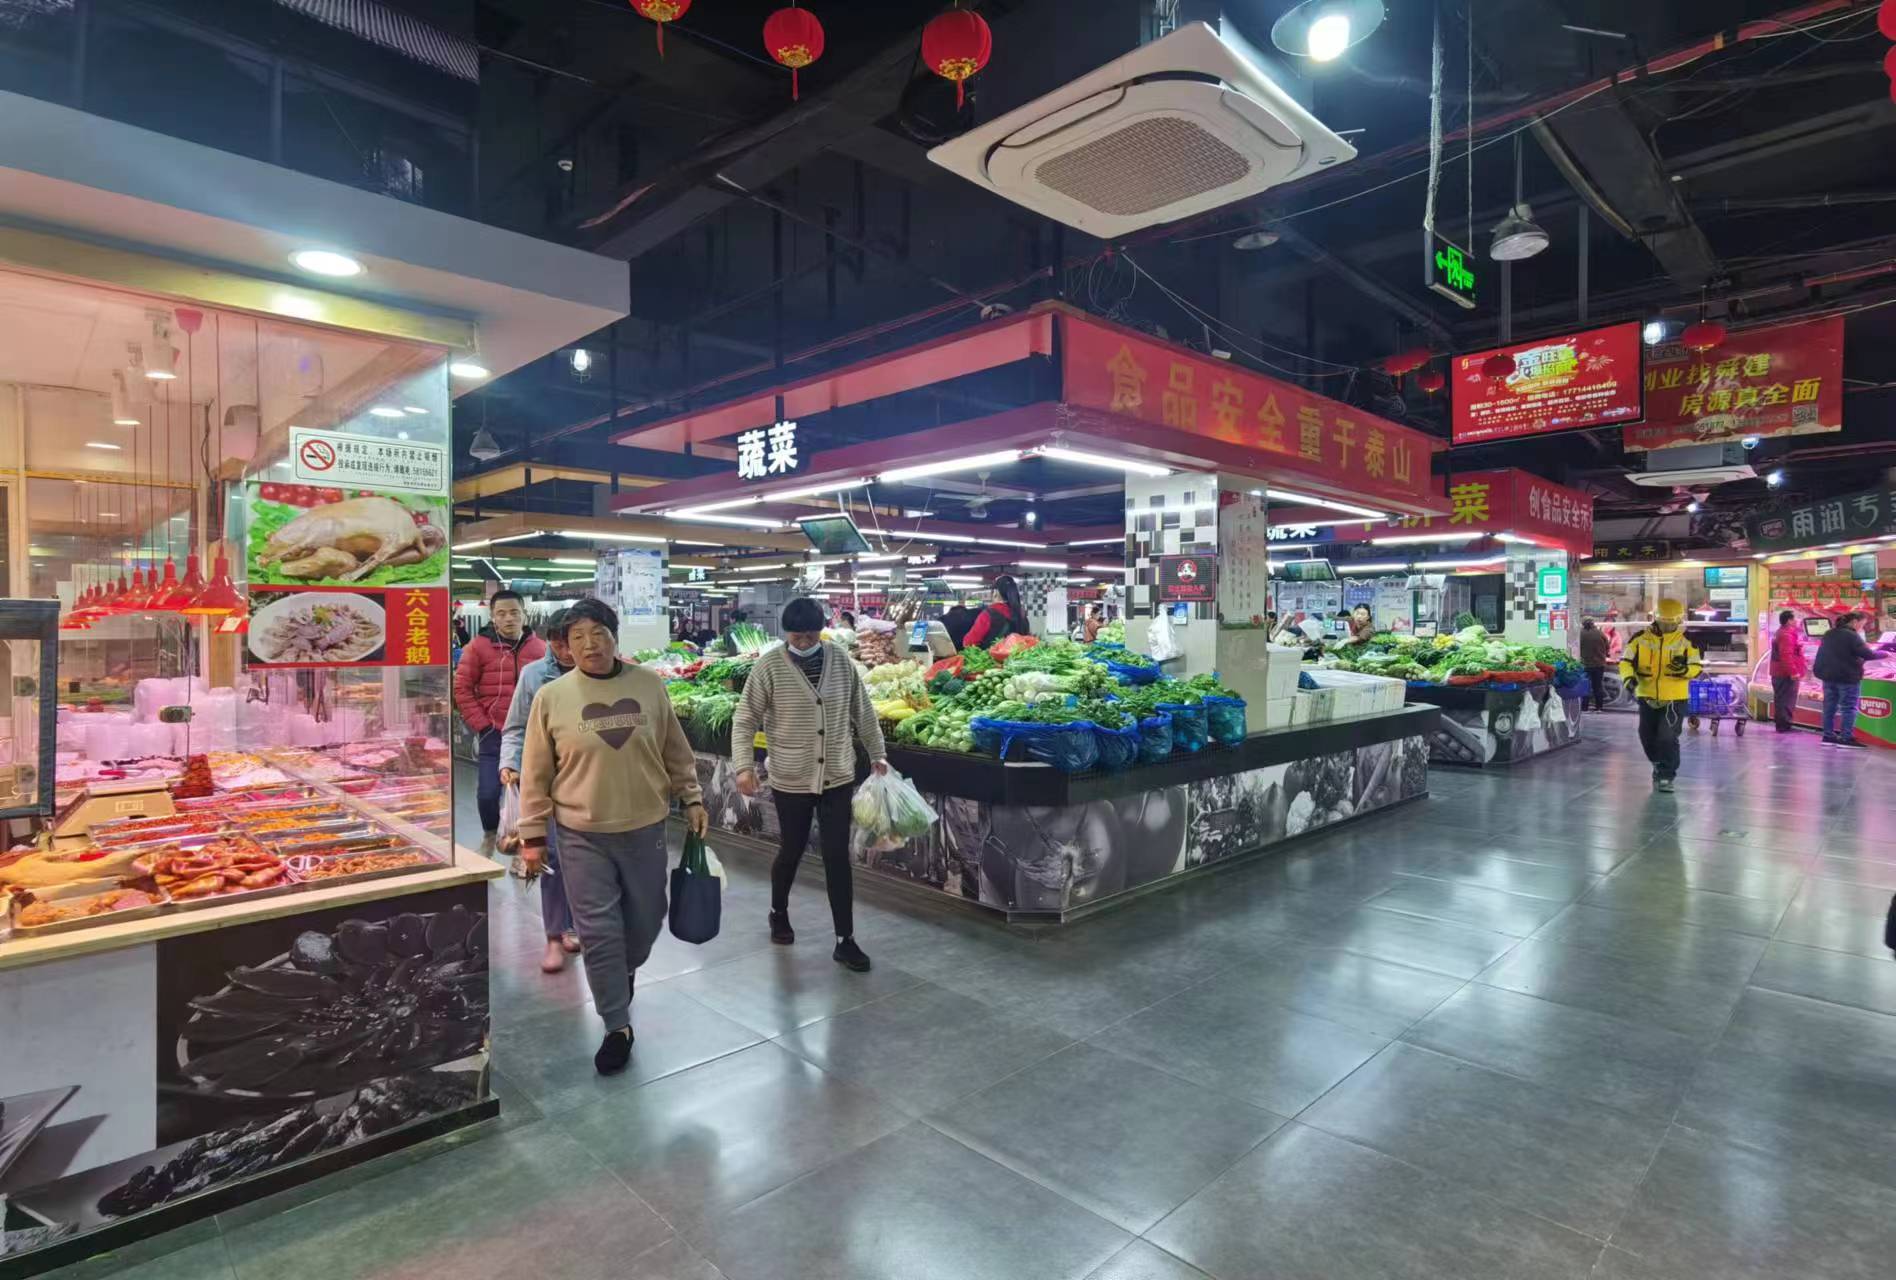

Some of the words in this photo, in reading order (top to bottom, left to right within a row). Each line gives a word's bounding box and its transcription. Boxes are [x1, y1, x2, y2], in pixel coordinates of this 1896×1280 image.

[1106, 344, 1411, 485] 食品安全重于泰山
[1679, 377, 1822, 416] 房源真全面
[737, 420, 798, 479] 蔬菜
[405, 589, 430, 665] 六合老鹅
